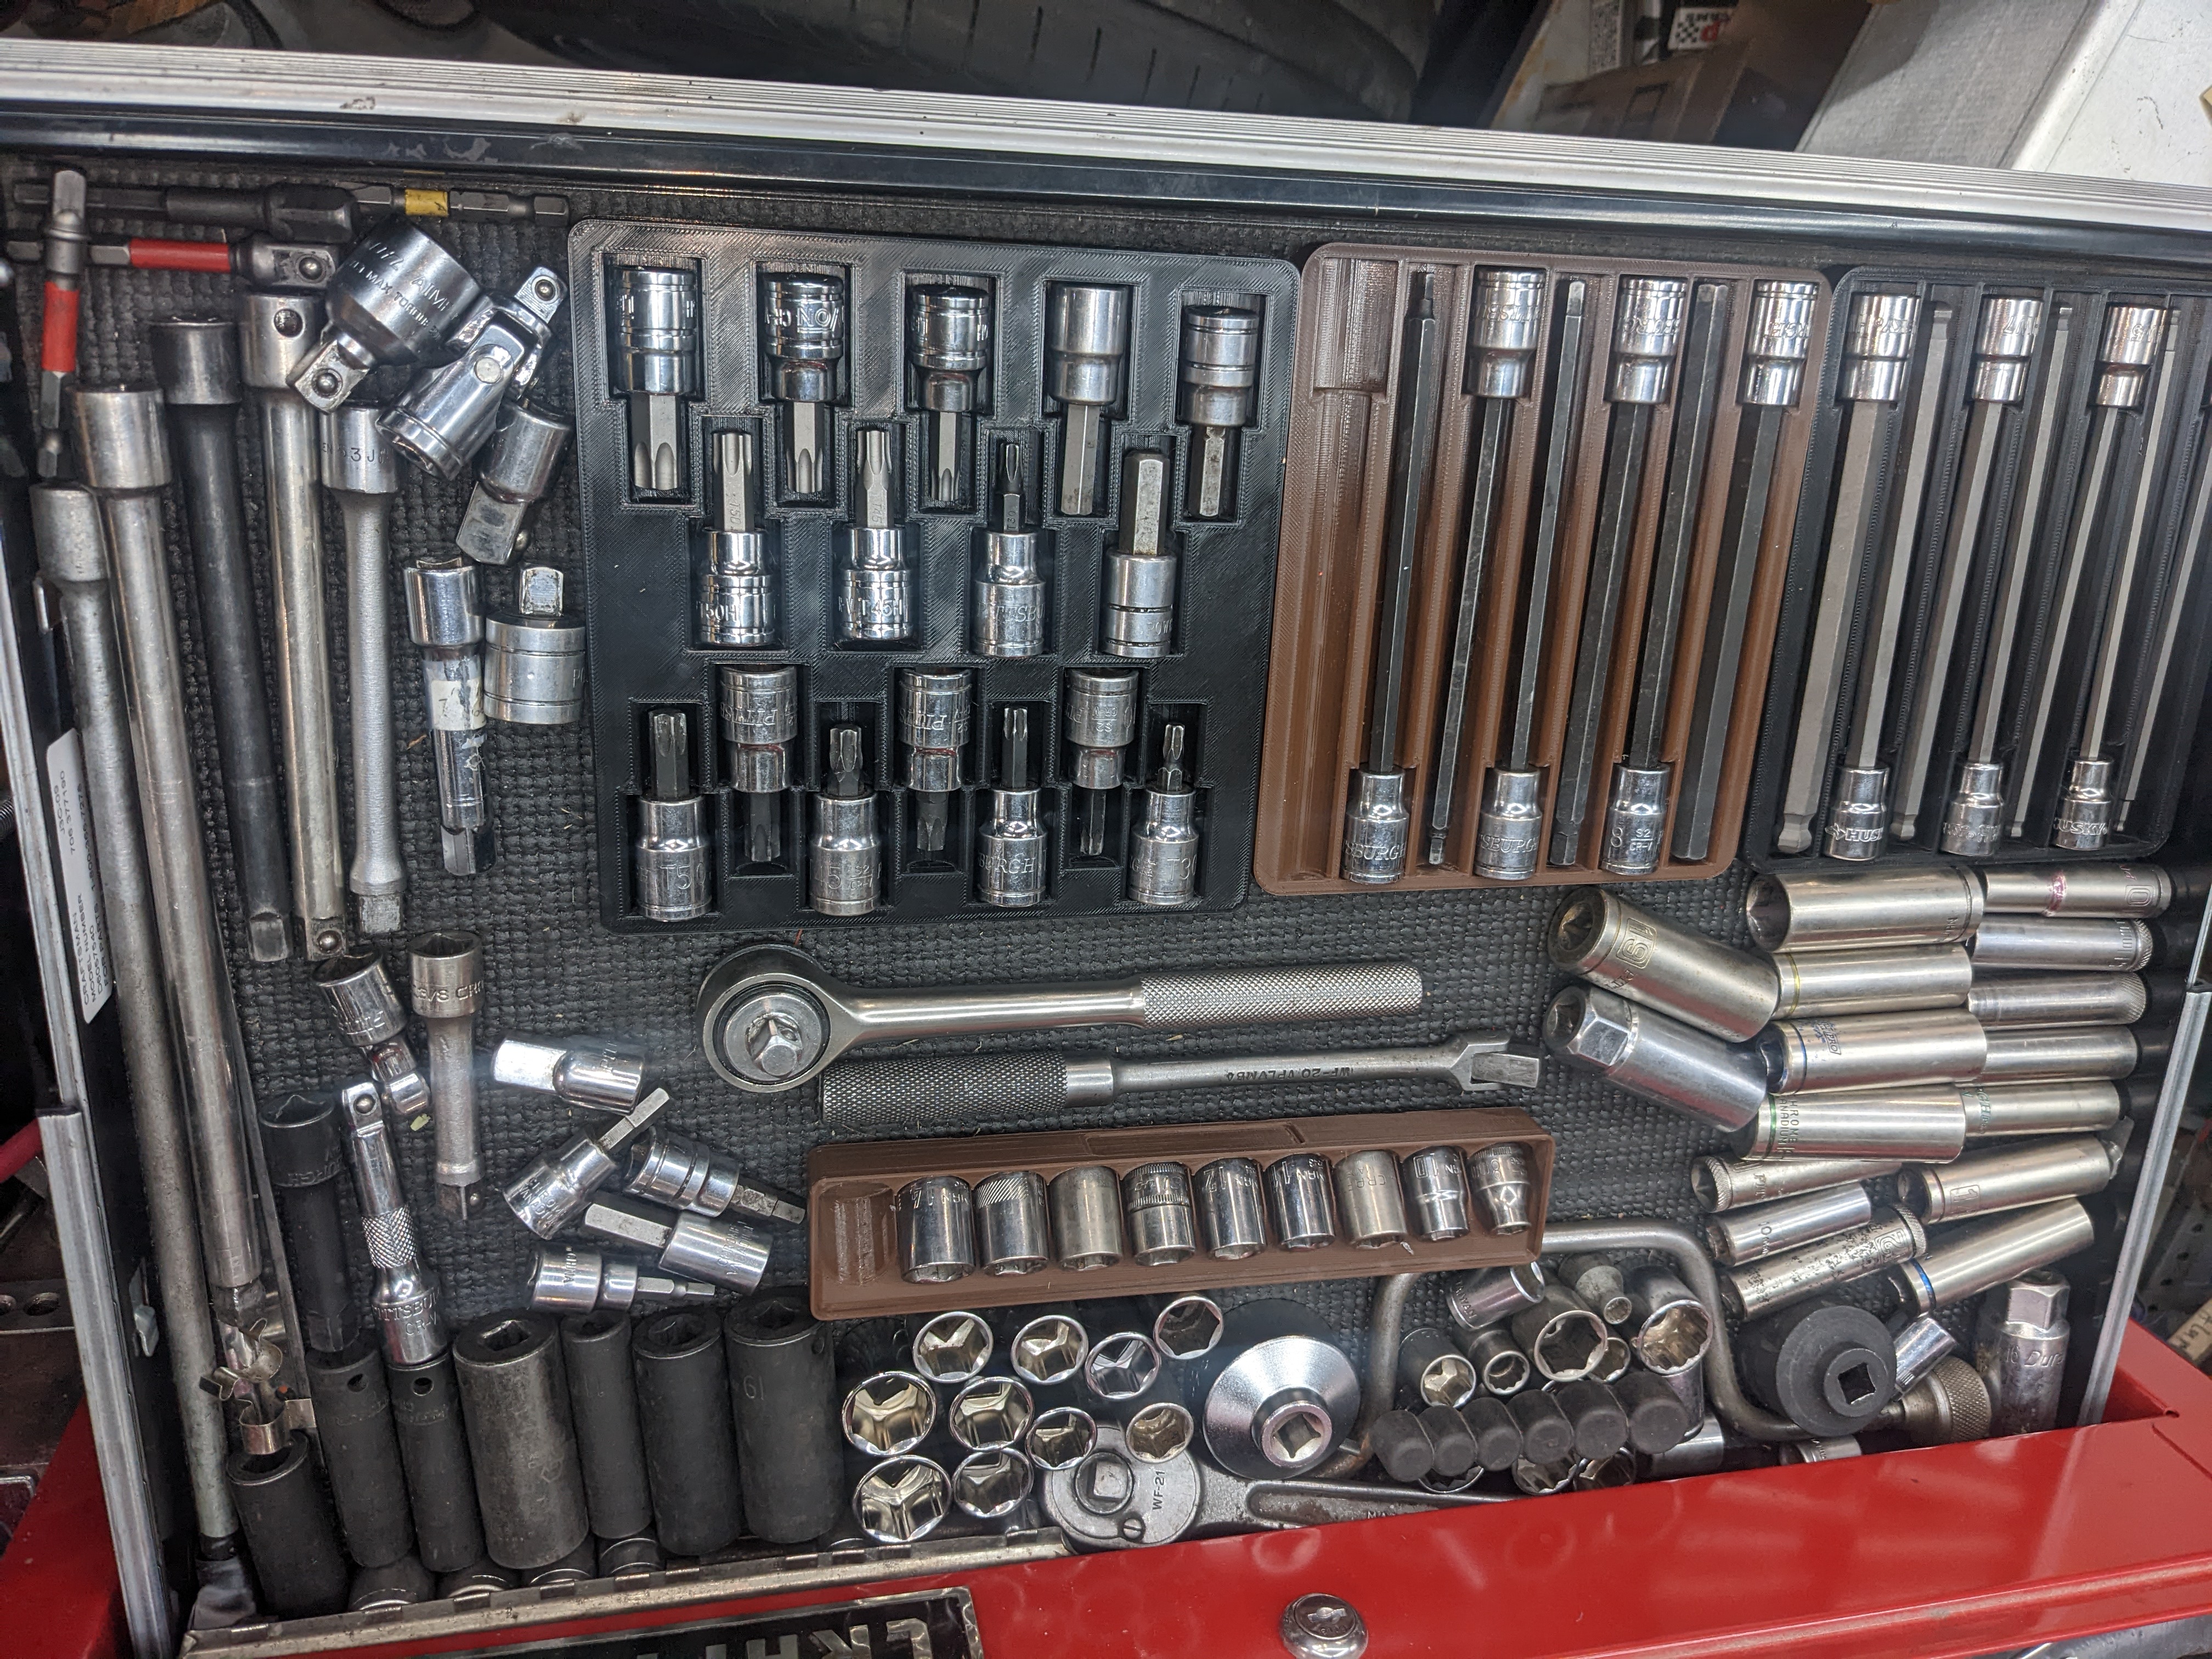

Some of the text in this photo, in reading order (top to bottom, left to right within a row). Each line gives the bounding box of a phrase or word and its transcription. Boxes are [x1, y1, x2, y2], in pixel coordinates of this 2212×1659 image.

[730, 504, 741, 525] T50
[872, 504, 883, 524] T45
[1007, 510, 1016, 530] T30
[1096, 721, 1113, 733] S2
[68, 827, 76, 856] 706
[1610, 826, 1623, 848] 8
[1636, 828, 1651, 838] S2
[855, 865, 870, 876] S2
[94, 902, 104, 952] PARTS
[72, 912, 90, 1006] CRAFTSMAN
[77, 893, 97, 1003] MODEL NUMBER
[101, 957, 110, 987] FOR
[1413, 1153, 1439, 1178] 10
[1152, 1470, 1166, 1510] WF-21
